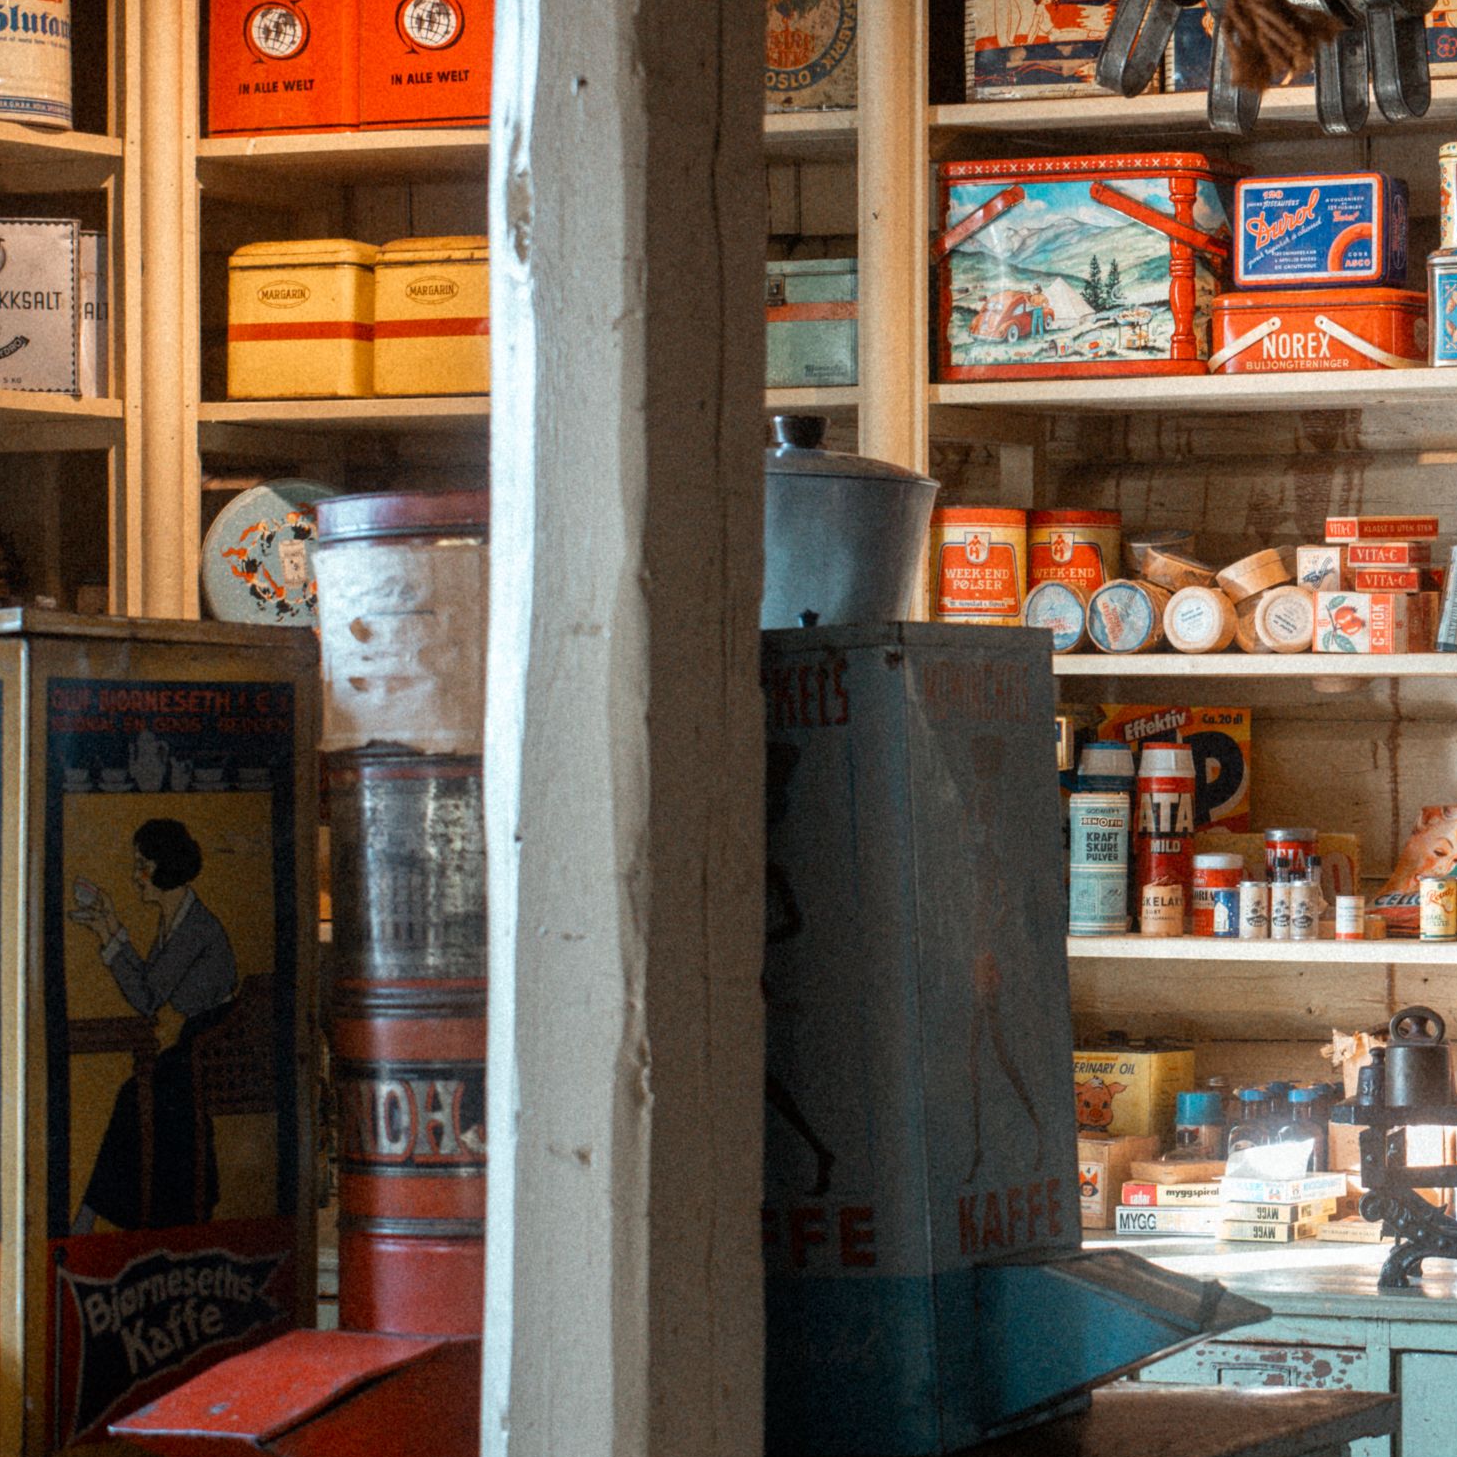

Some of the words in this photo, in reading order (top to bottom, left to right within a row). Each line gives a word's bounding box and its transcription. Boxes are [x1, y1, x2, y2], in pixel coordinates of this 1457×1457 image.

[391, 74, 403, 86] IN
[407, 72, 433, 84] ALLE
[436, 70, 470, 84] WELT
[238, 83, 251, 95] IN
[254, 81, 279, 93] ALLE
[283, 79, 315, 92] WELT
[1246, 188, 1321, 251] Durol
[260, 288, 306, 300] MARGARIN
[409, 284, 455, 296] MARGARIN
[1263, 332, 1330, 359] NOREX
[1246, 359, 1350, 371] BULJONGTERNINGER
[1356, 548, 1398, 561] VITA-C
[952, 580, 1003, 591] PØLSER
[1365, 574, 1407, 587] VITA-C
[1124, 710, 1186, 742] Effektiv
[1138, 793, 1194, 833] ATA
[1086, 832, 1119, 842] KRAFT
[1086, 842, 1119, 852] SKURE
[1151, 840, 1181, 853] MILD
[1086, 853, 1119, 862] PULVER
[1119, 1062, 1136, 1075] OIL
[956, 1177, 1063, 1255] KAFFE
[1119, 1212, 1157, 1231] MYGG
[120, 1297, 225, 1376] Kaffe
